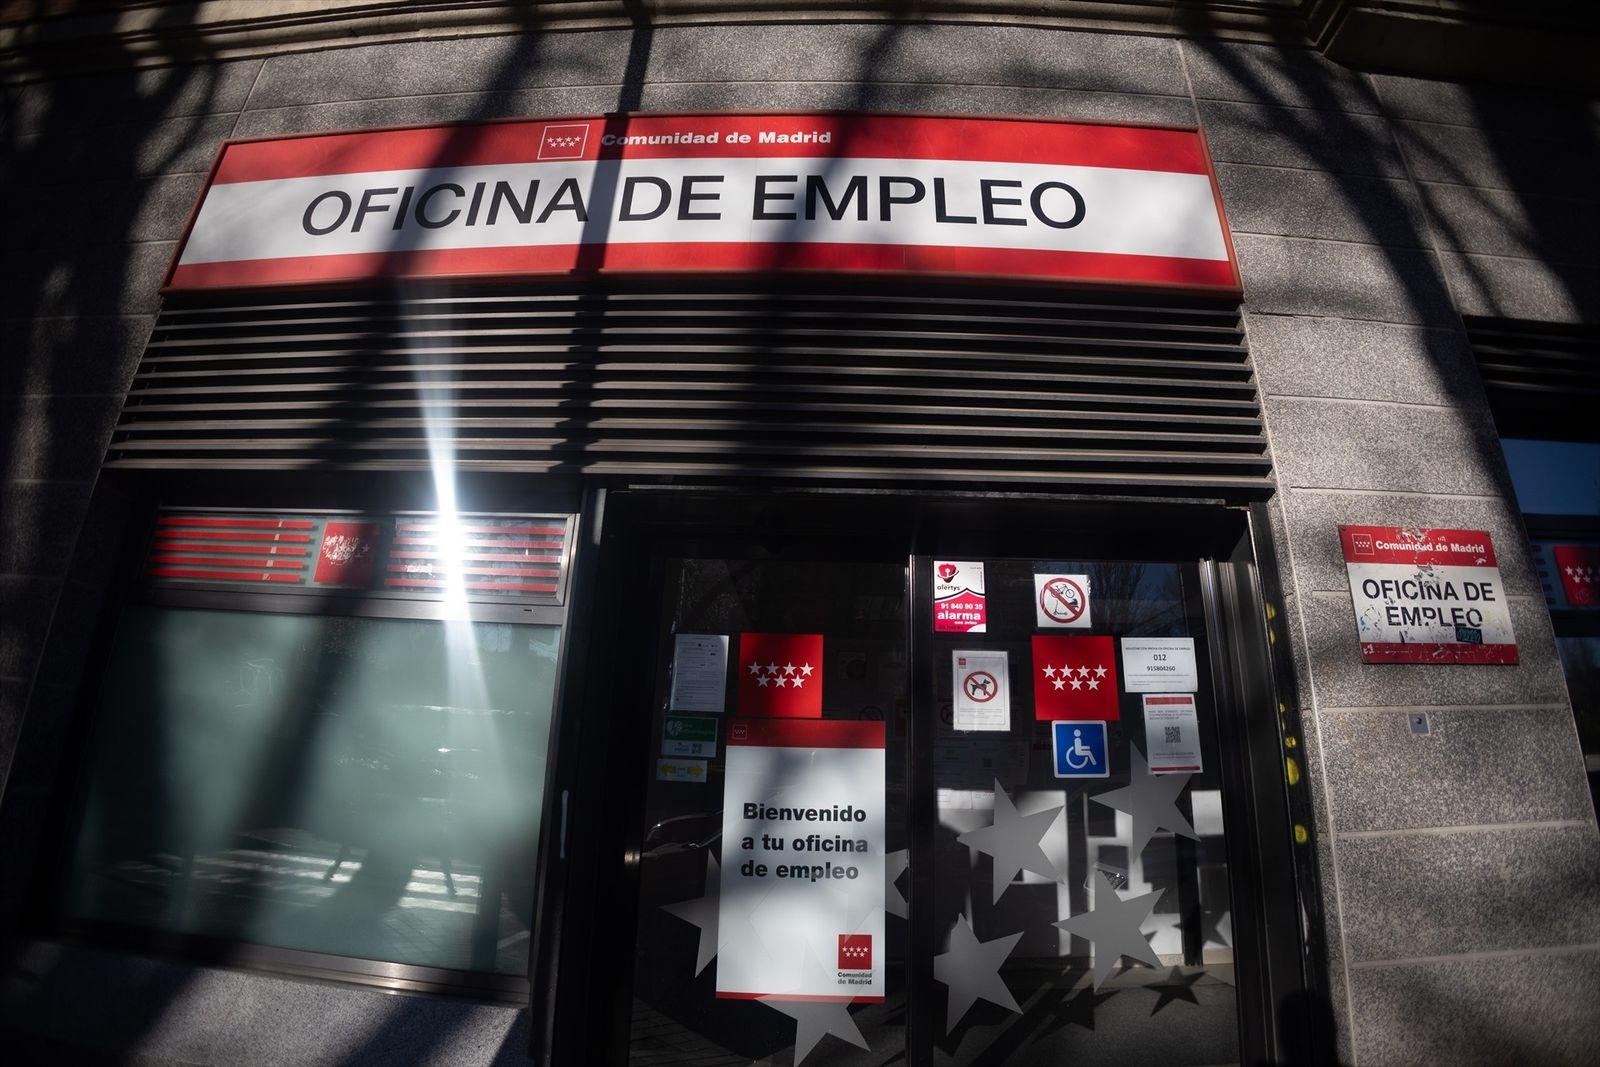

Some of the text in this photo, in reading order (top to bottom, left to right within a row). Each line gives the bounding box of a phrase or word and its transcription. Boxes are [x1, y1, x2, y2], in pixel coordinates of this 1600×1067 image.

[601, 131, 832, 147] Comunidad de Madrid
[302, 175, 1087, 236] OFICINA DE EMPLEO
[1375, 540, 1485, 554] Comunidad de Madrid
[1362, 578, 1496, 602] OFICINA DE
[937, 611, 981, 620] alarma
[1385, 606, 1483, 628] EMPLEO
[743, 802, 867, 822] Bienvenido
[741, 834, 868, 852] a tu oficina
[741, 860, 859, 882] de empleo
